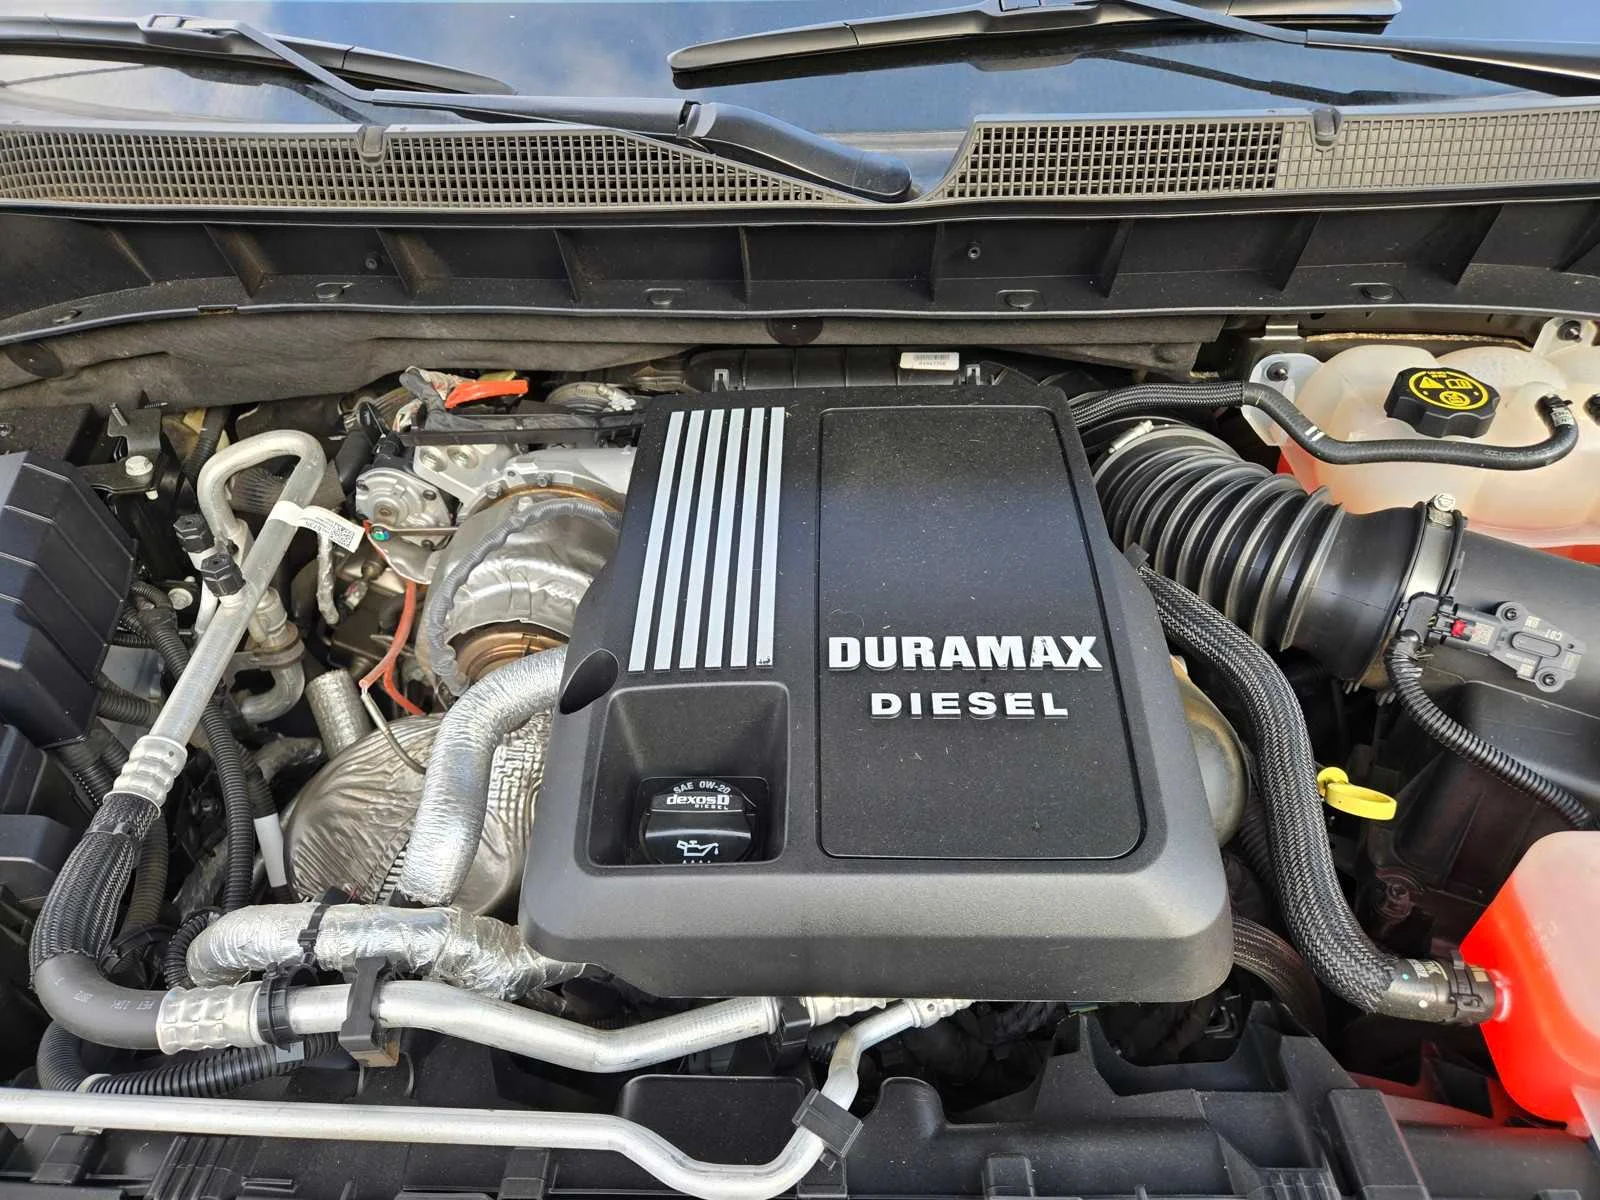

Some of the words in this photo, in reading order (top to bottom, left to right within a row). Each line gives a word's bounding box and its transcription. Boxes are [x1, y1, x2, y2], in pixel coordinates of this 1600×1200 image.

[828, 635, 1103, 671] DURAMAX
[871, 691, 1069, 719] DIESEL
[673, 781, 694, 794] SAE
[699, 780, 731, 794] 0W-20
